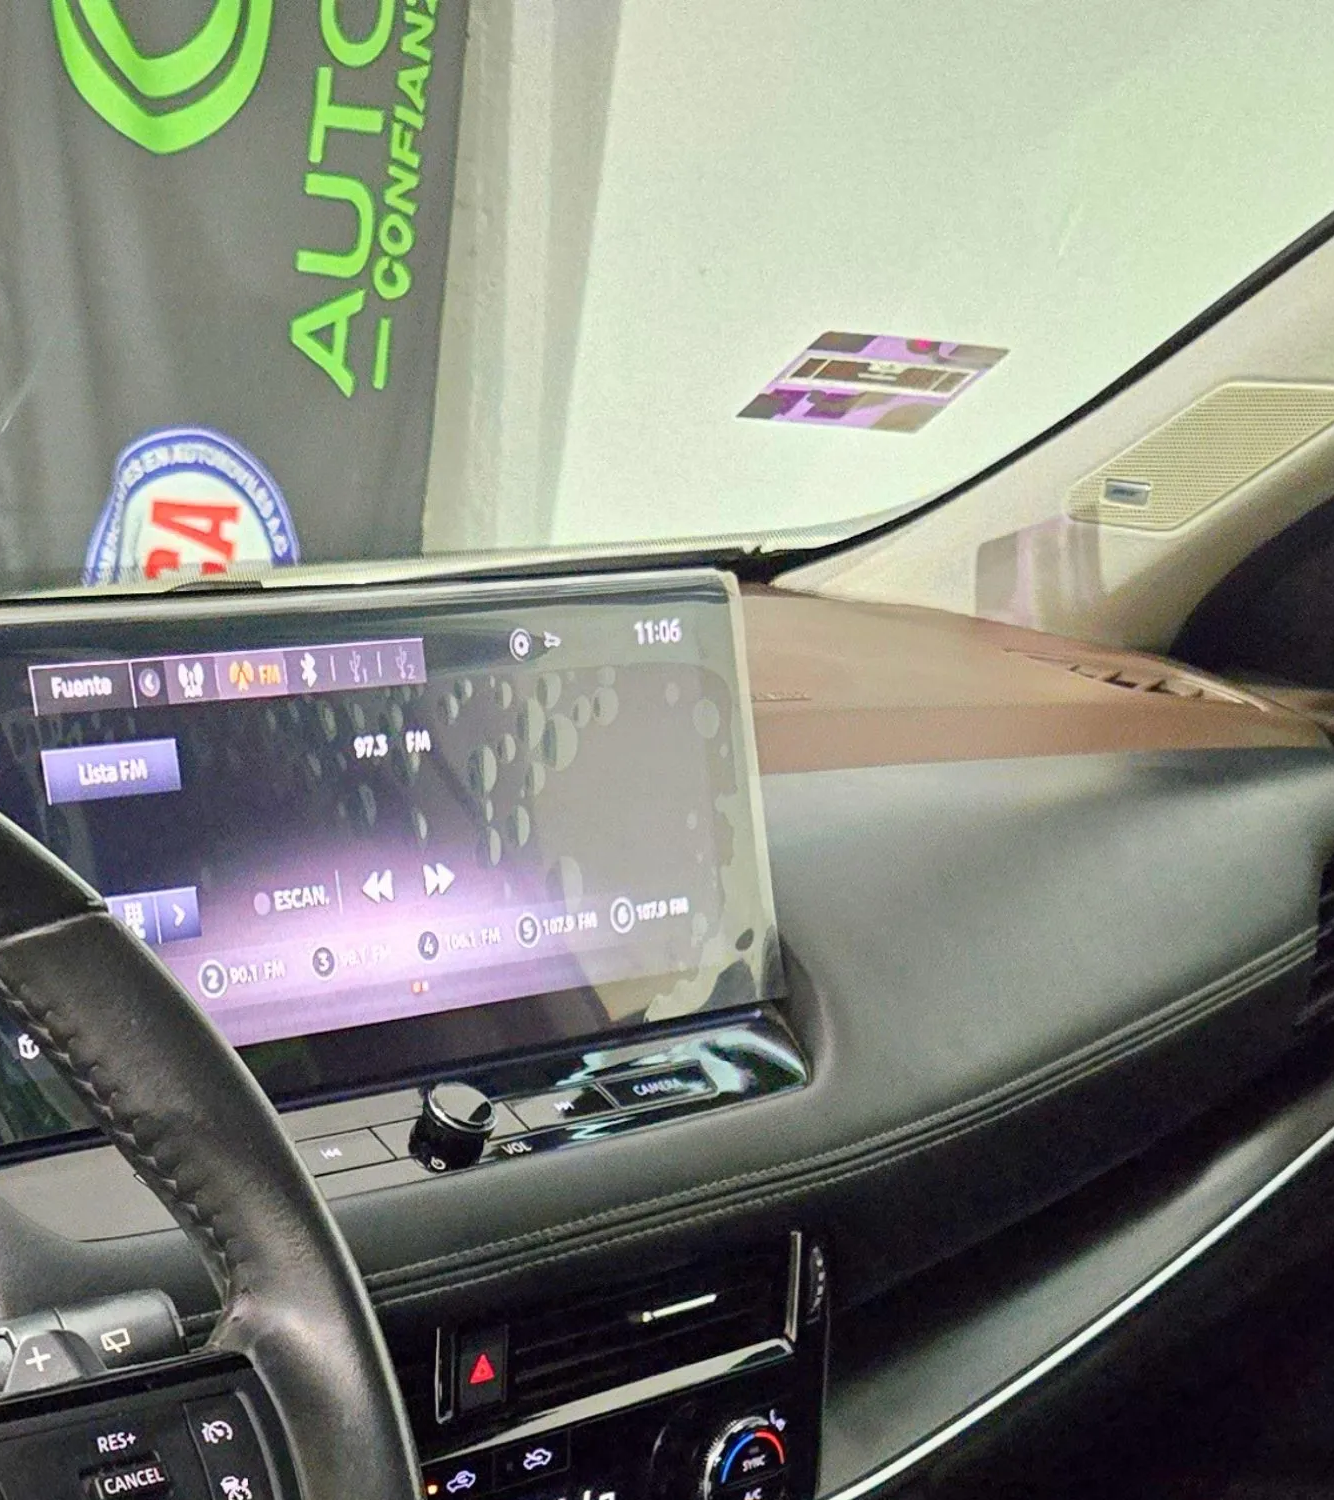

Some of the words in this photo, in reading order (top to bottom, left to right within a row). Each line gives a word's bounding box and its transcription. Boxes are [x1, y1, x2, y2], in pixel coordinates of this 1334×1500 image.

[634, 618, 682, 645] 11:06
[50, 674, 113, 700] Fuente
[258, 665, 282, 686] FM
[405, 729, 431, 754] FM
[77, 760, 118, 787] Lista
[119, 756, 149, 782] FM
[273, 885, 330, 912] ESCAN.
[500, 1139, 533, 1156] VOL
[96, 1431, 137, 1454] RES+
[103, 1466, 166, 1496] CANCEL
